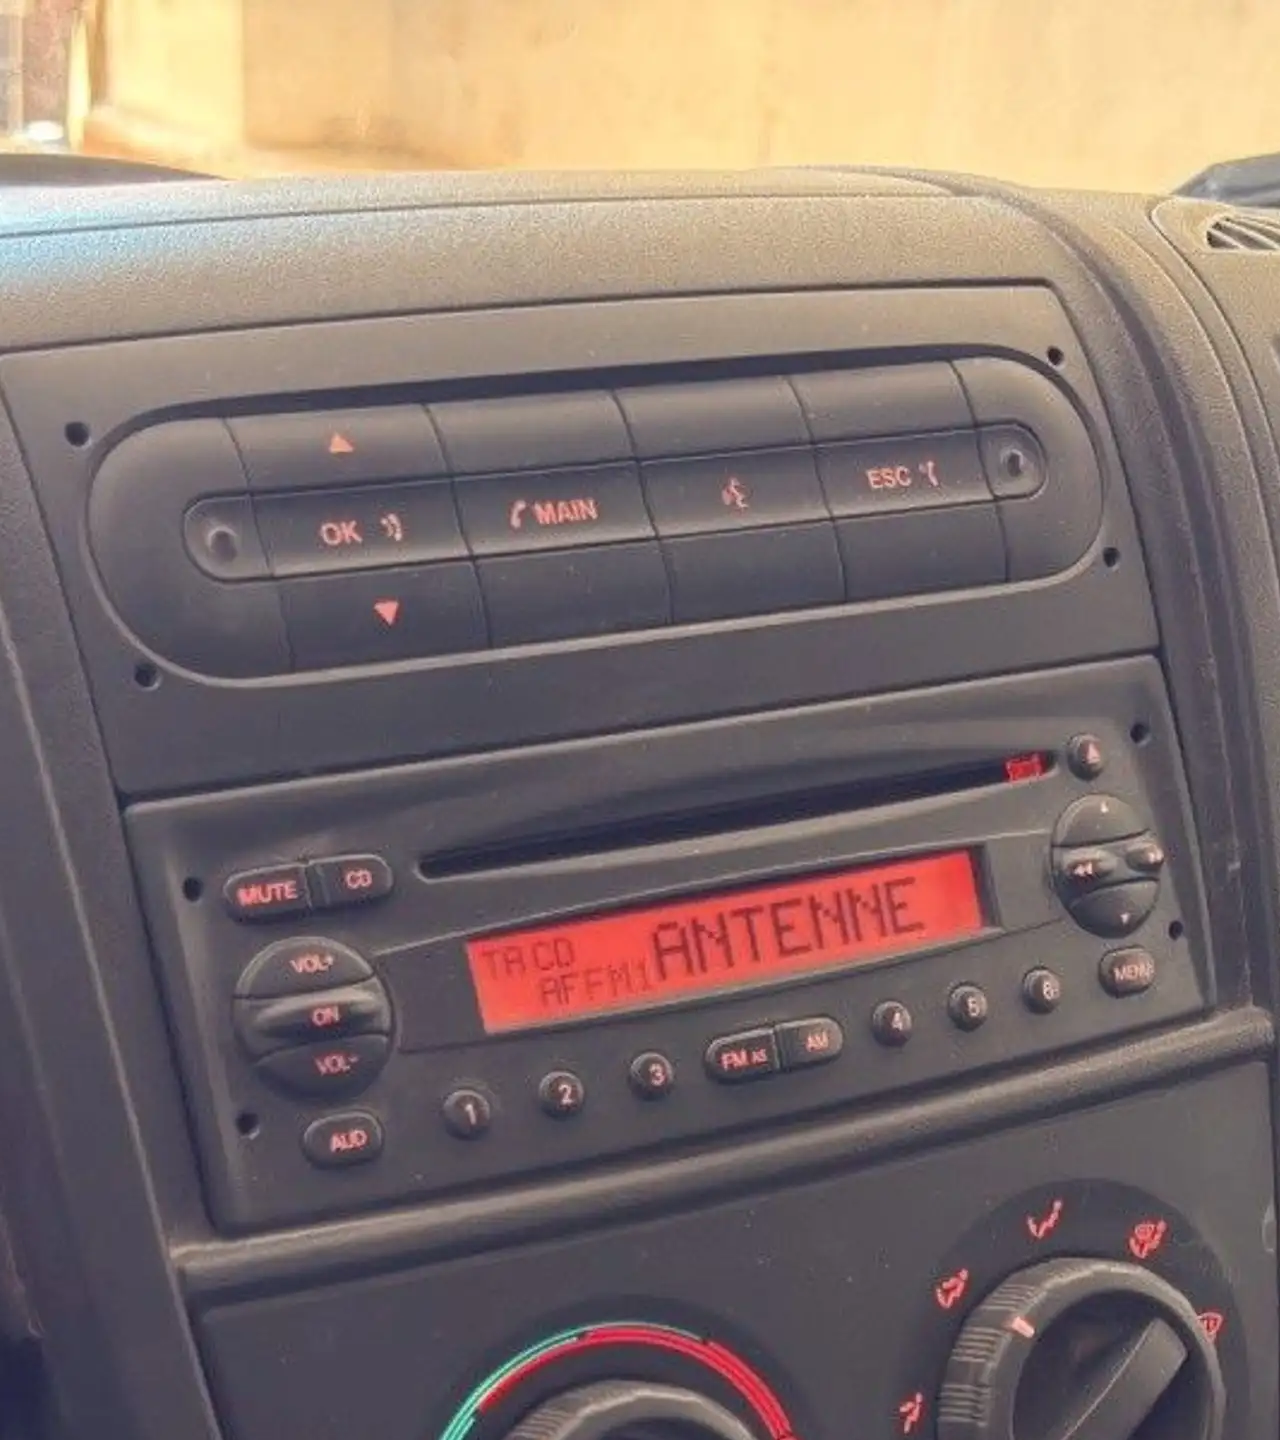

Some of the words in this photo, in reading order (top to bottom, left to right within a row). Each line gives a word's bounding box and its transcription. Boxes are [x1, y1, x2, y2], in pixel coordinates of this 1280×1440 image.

[866, 467, 912, 489] ESC
[534, 498, 599, 526] MAIN
[321, 521, 363, 546] OK
[345, 869, 372, 889] CD
[237, 880, 298, 906] MUTE
[652, 876, 925, 982] ANTENNE
[531, 937, 576, 972] CD
[312, 1005, 340, 1025] ON
[649, 1063, 665, 1086] 3
[558, 1083, 572, 1105] 2
[464, 1103, 477, 1125] 1
